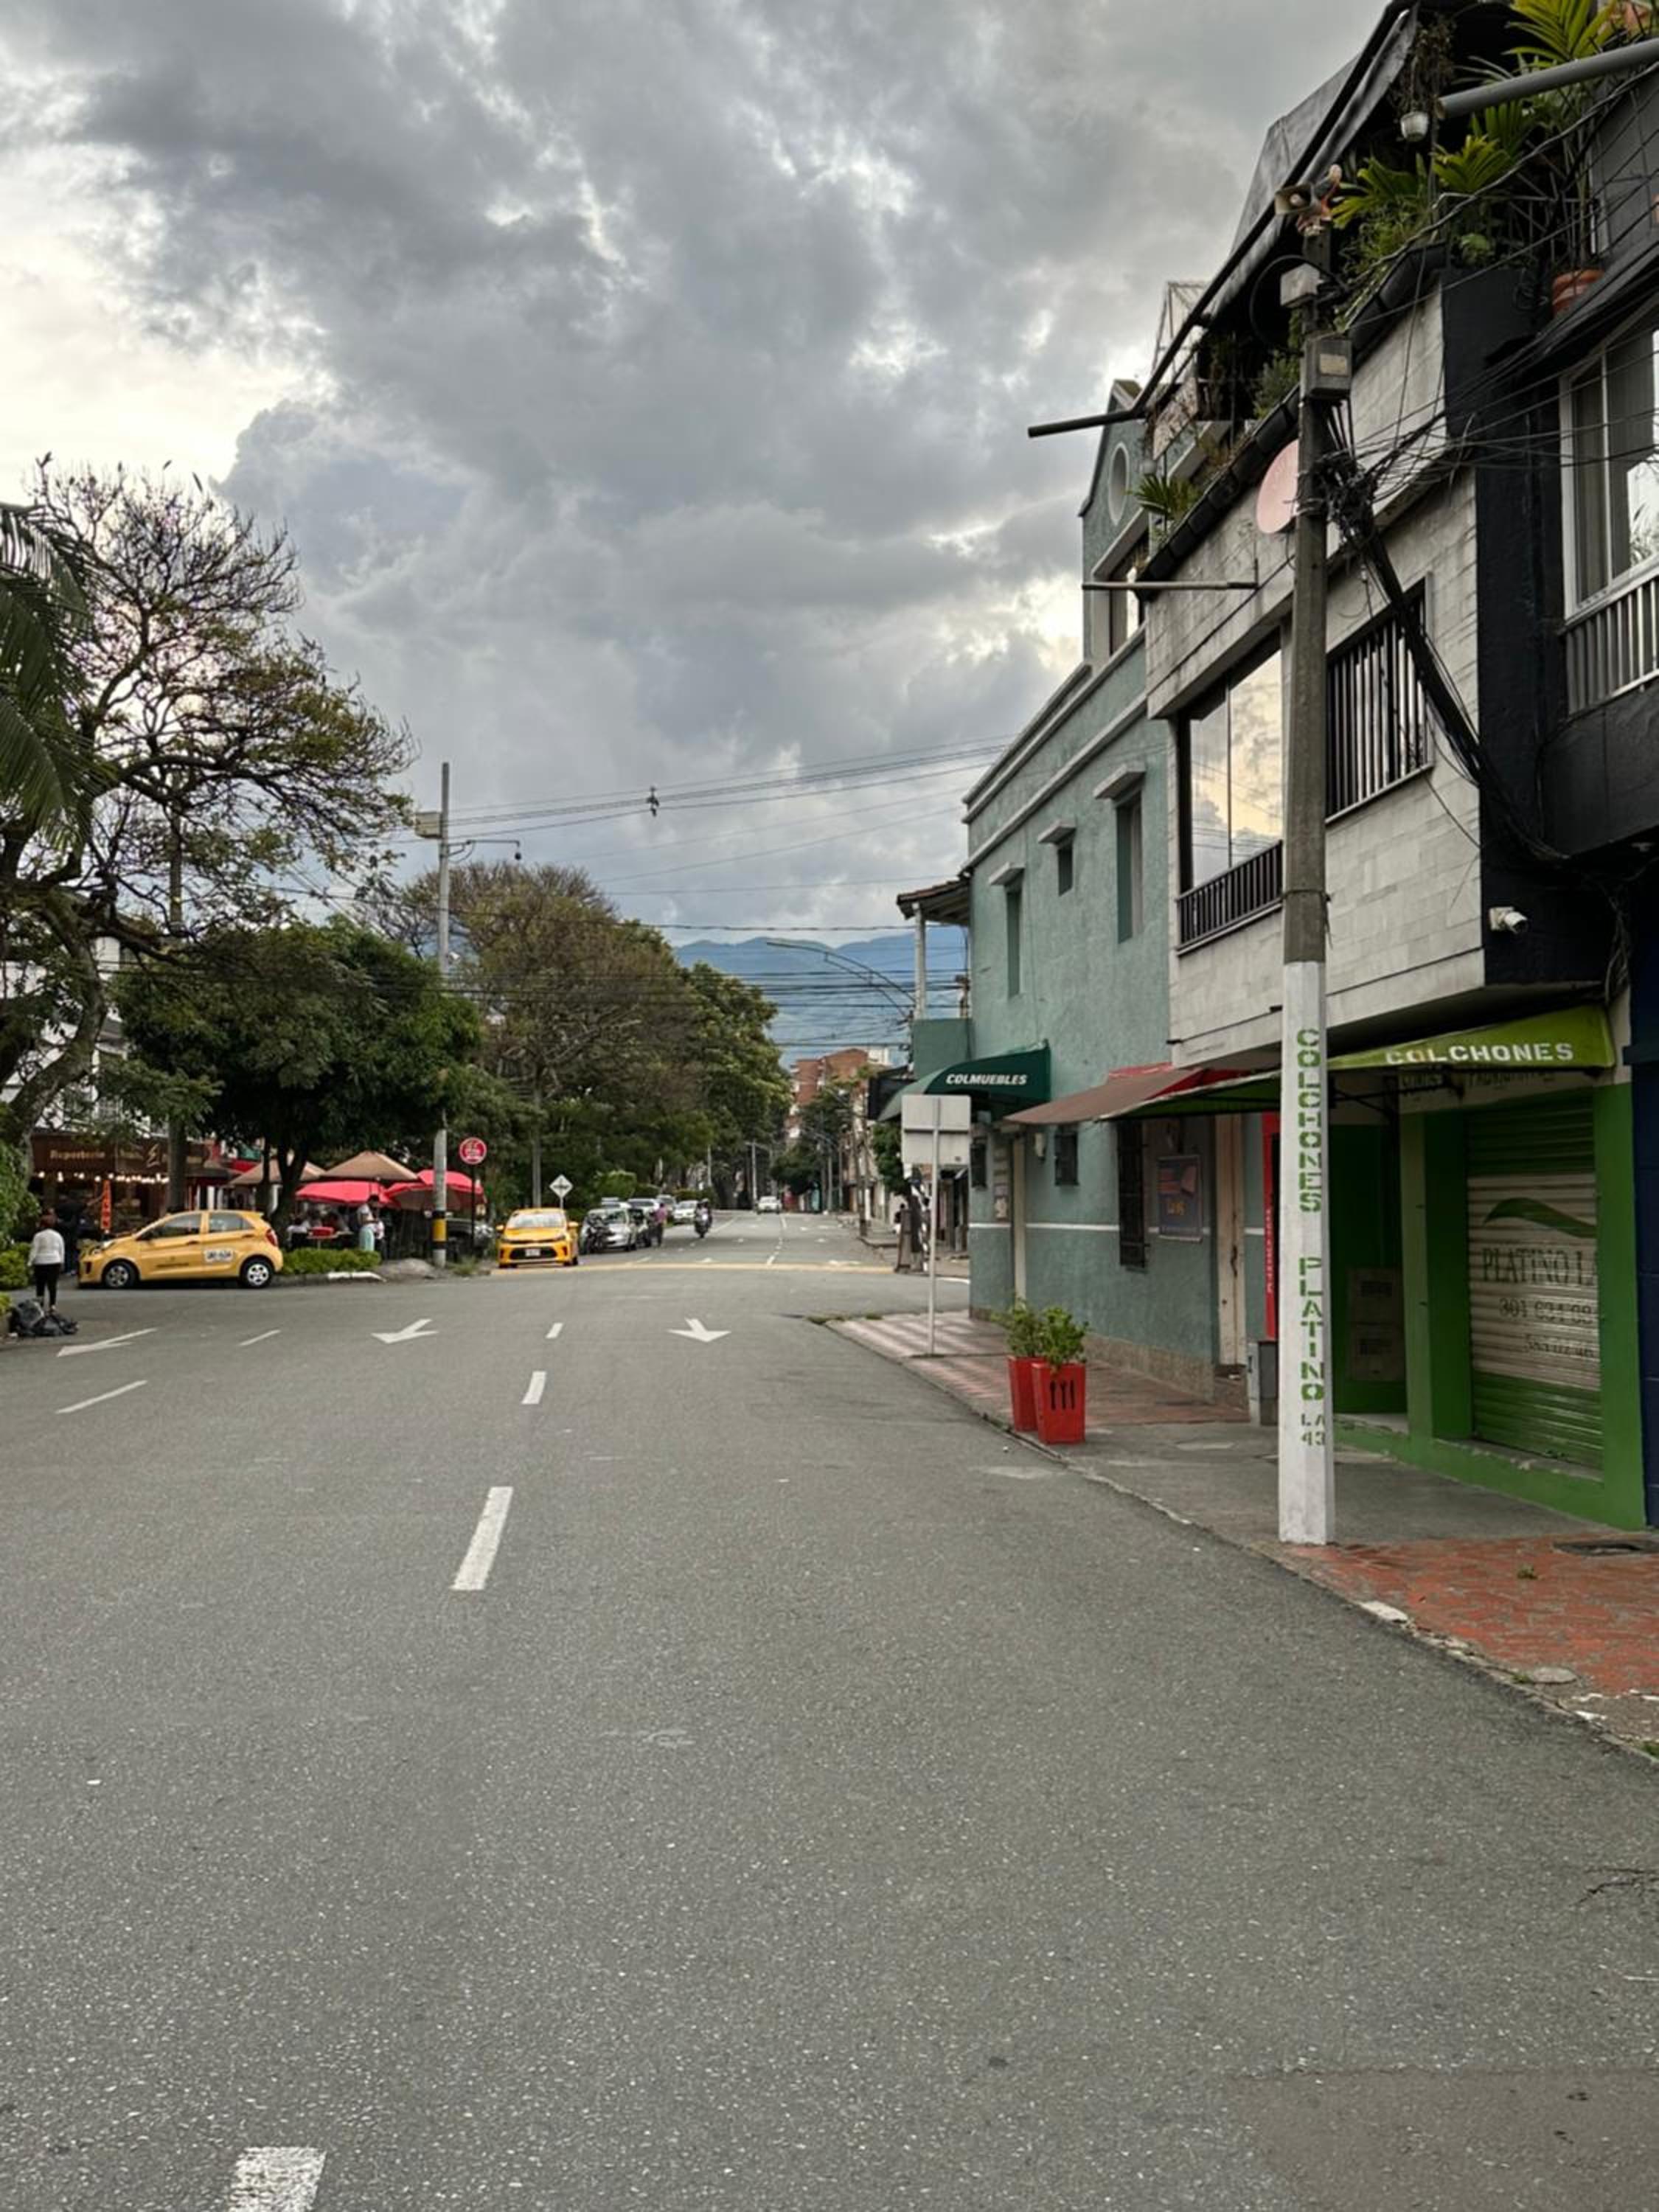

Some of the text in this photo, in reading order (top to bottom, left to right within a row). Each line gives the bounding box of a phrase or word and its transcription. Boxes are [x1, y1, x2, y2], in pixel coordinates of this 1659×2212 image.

[1386, 1043, 1573, 1064] COLCHONES
[945, 1073, 1027, 1085] COLMUEBLES
[1297, 1029, 1324, 1400] COLCHONES PLATINO
[1482, 1248, 1569, 1284] PLATINO
[1301, 1431, 1326, 1446] 43
